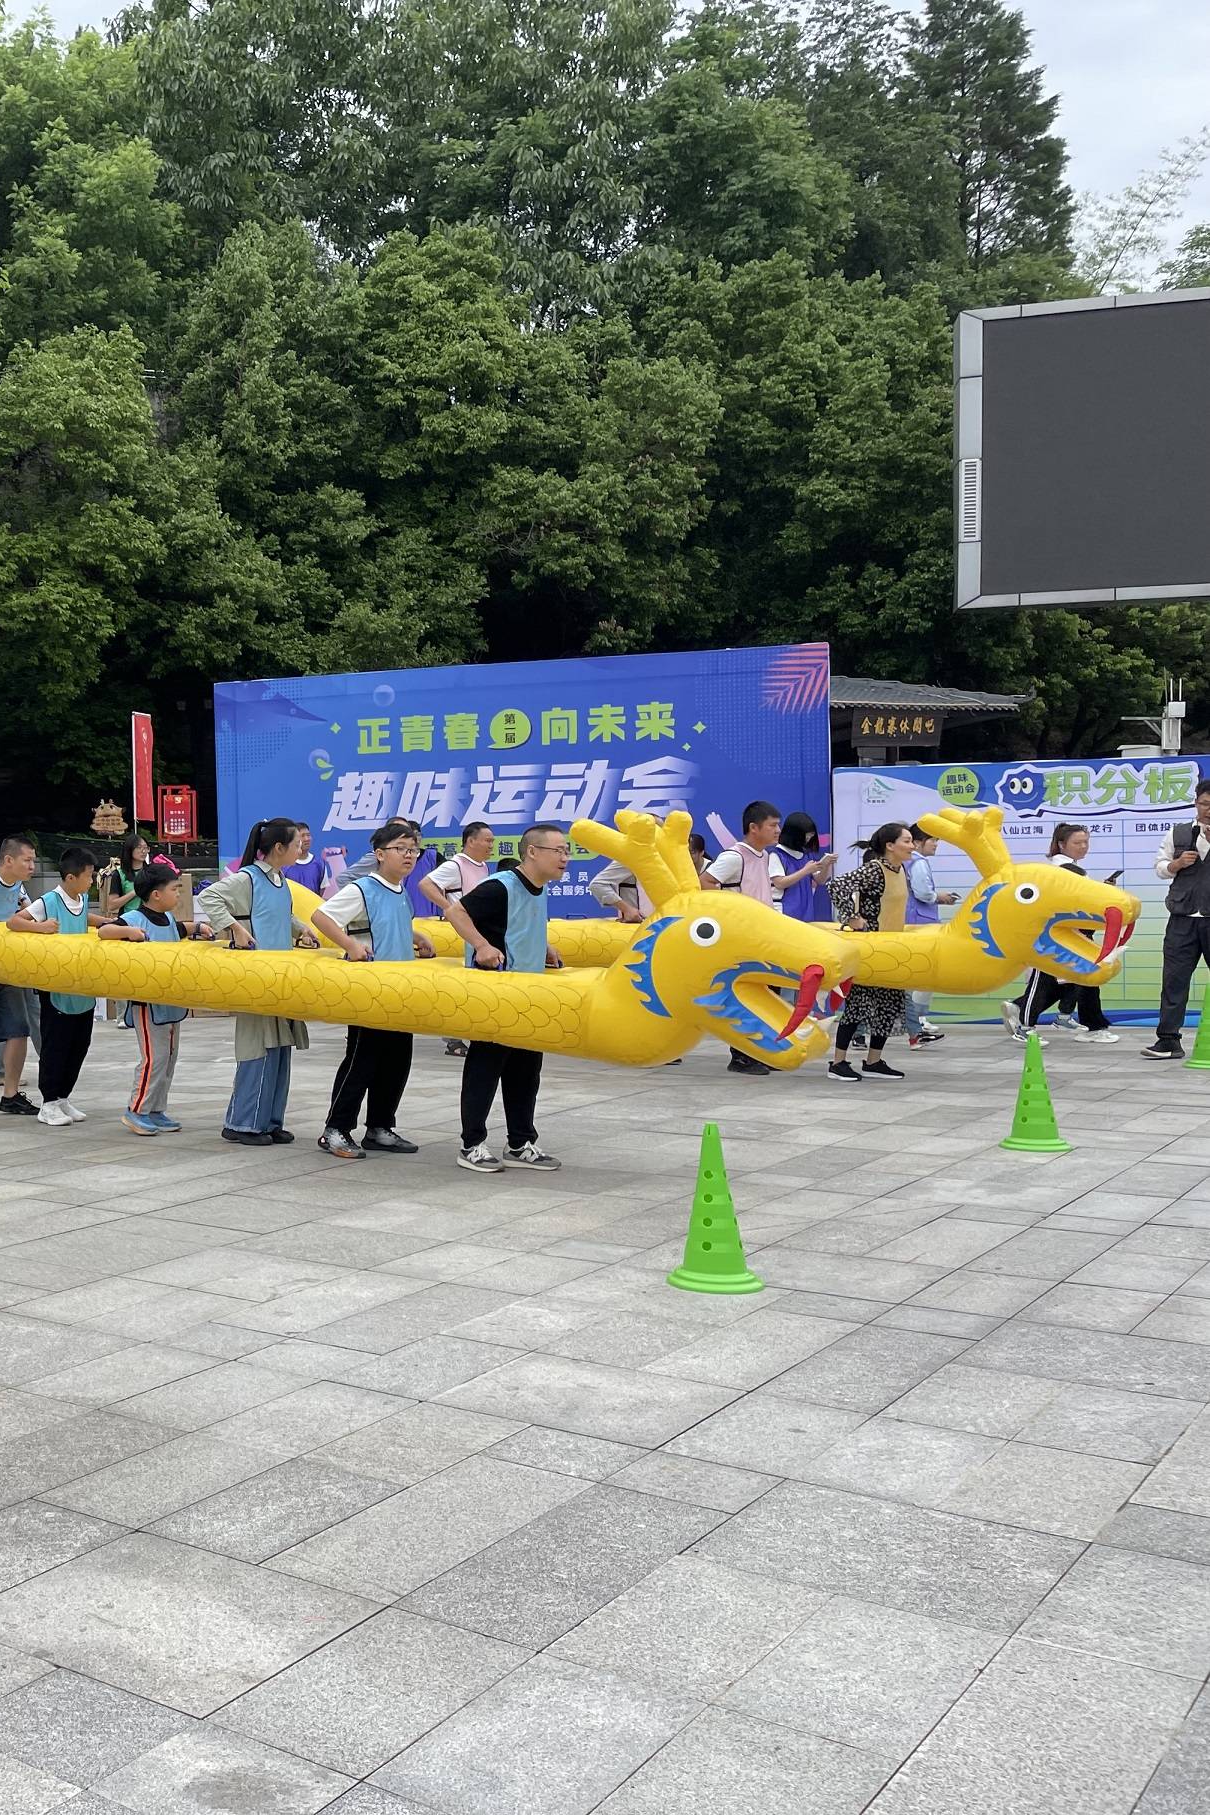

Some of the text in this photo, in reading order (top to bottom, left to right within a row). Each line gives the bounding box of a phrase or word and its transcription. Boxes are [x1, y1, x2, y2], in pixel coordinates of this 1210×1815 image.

[357, 701, 676, 754] 正青春 向未来
[503, 713, 517, 745] 第一届
[322, 755, 696, 832] 趣味运动会
[941, 783, 975, 796] 运动会
[946, 773, 969, 785] 趣味
[1043, 766, 1195, 807] 积分板
[1082, 823, 1113, 833] 龙行
